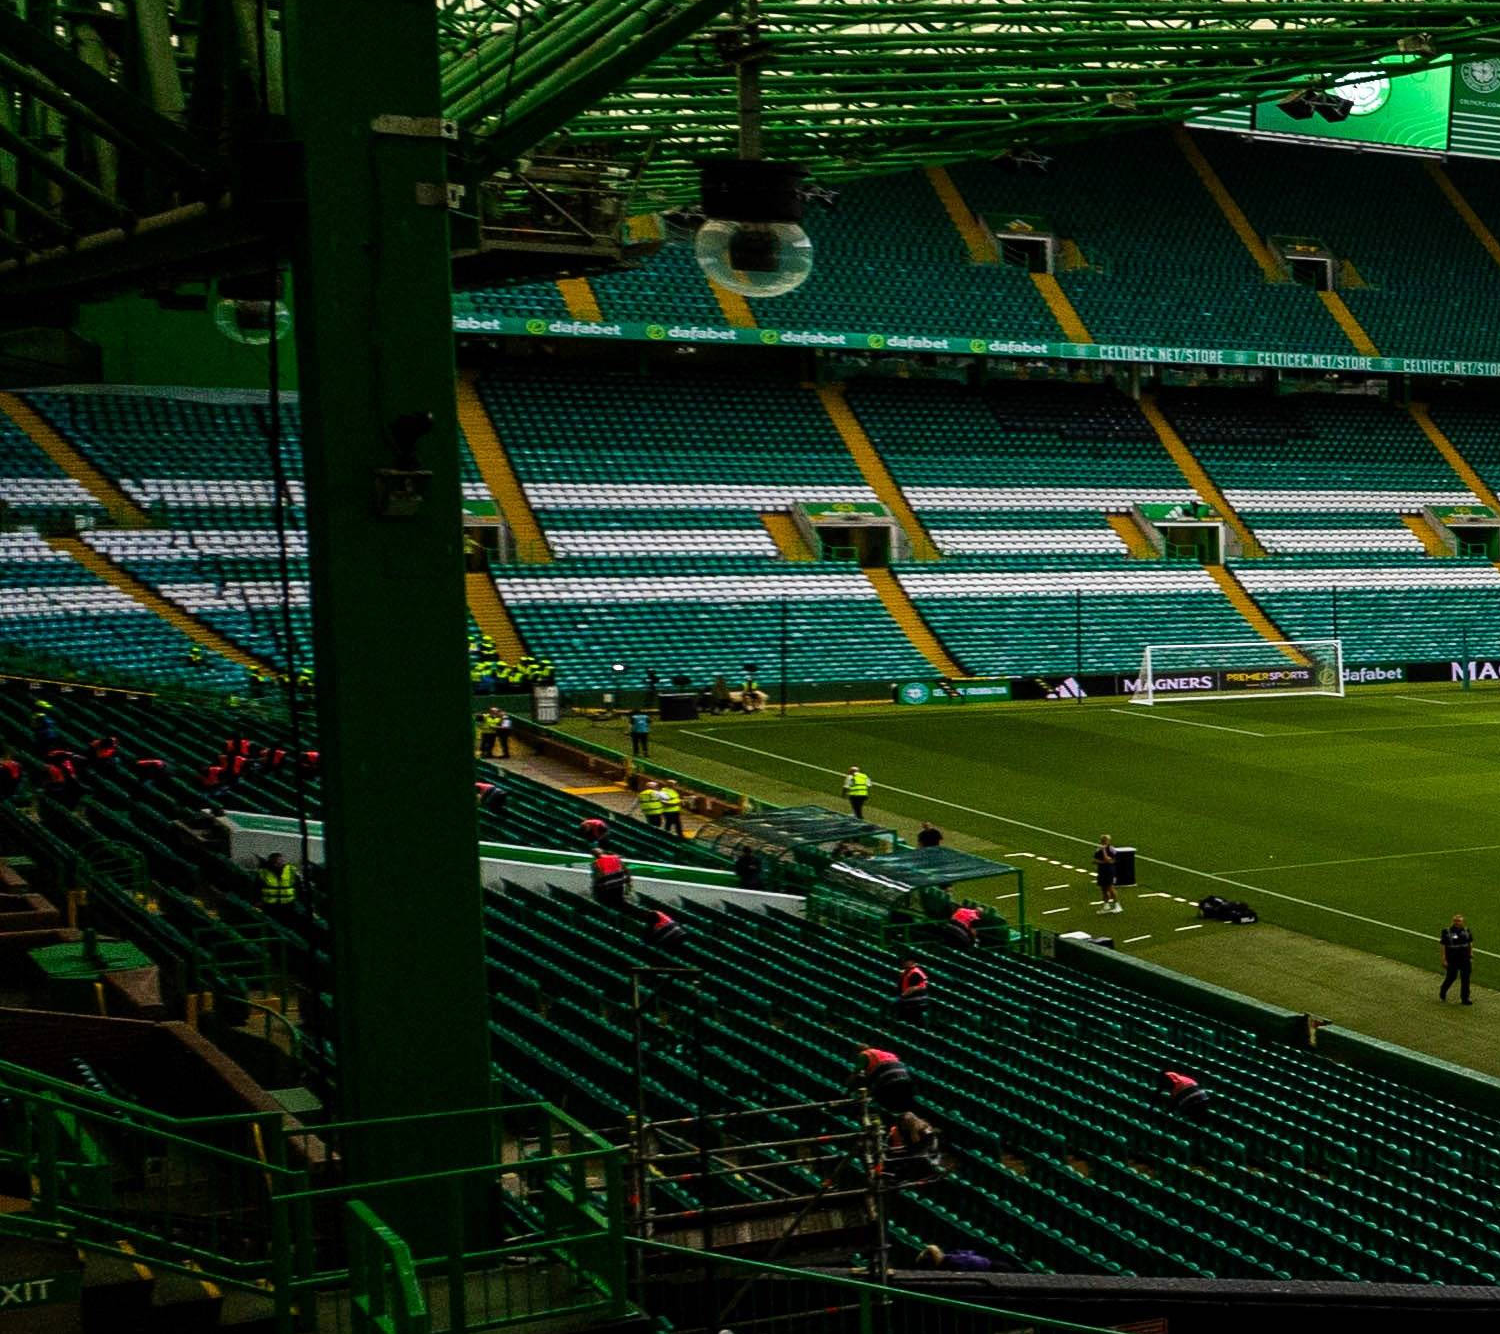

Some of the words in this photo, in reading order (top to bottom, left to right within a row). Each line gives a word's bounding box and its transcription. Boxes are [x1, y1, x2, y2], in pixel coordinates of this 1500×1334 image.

[548, 319, 622, 337] dafabet
[667, 325, 738, 342] dafabet
[780, 329, 846, 346] dafabet
[886, 336, 949, 351] dafabet
[989, 340, 1048, 355] dafabet
[1123, 676, 1213, 692] MAGNERS
[1342, 667, 1402, 684] dafabet
[0, 1278, 55, 1305] XIT
